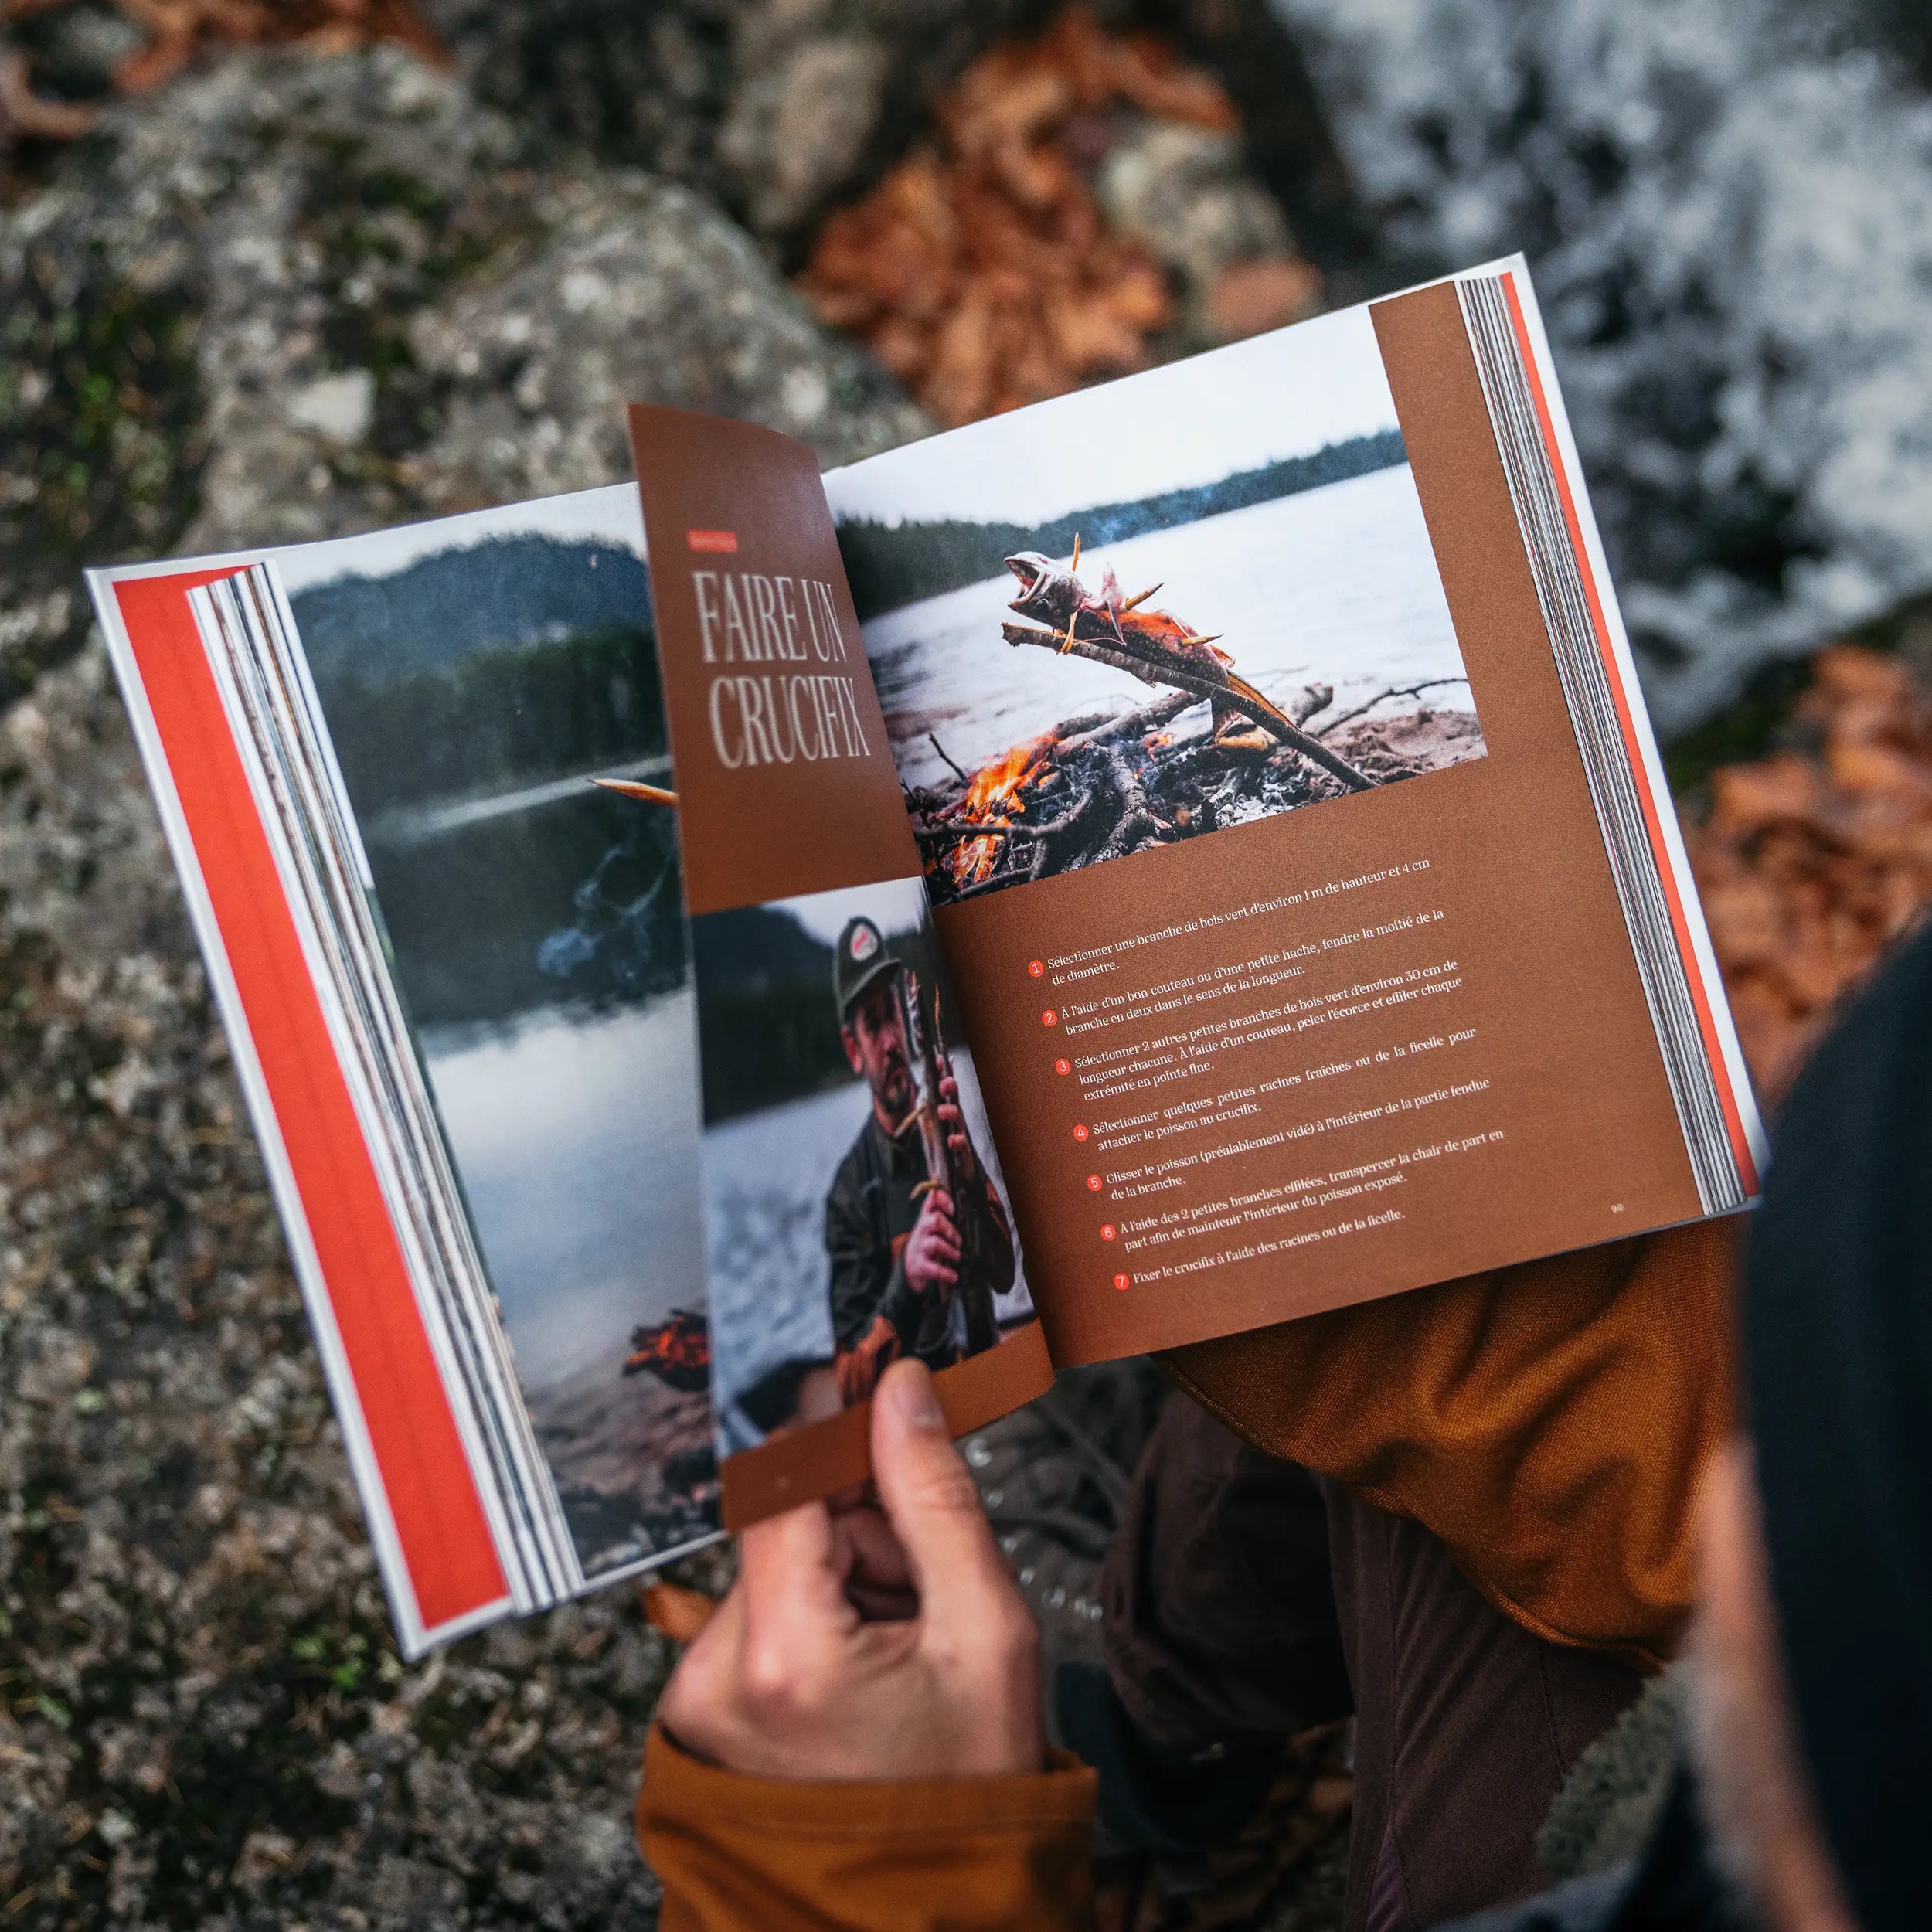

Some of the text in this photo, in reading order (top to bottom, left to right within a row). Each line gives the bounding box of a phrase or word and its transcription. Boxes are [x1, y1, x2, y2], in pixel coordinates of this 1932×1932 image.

[692, 571, 847, 662] FAIRE UN
[709, 675, 870, 768] CRUCIFIX
[1032, 860, 1430, 974] 1 Sélectionner une branche de bois vert d'environ 1 m de hauteur et 4 cm
[1046, 910, 1444, 1023] 2 À l'aide d'un bon couteau ou d'une petite hache, fendre la moitié de la
[1053, 962, 1119, 985] de diamètre.
[1066, 967, 1304, 1035] branche en deux dans le sens de la longueur.
[1060, 961, 1458, 1072] 3 Sélectionner 2 autres petites branches de bois vert d'environ 30 cm de
[1079, 978, 1462, 1084] longueur chacune. À l'aide d'un couteau, peler l'écorce et effiler chaque
[1078, 1029, 1475, 1138] 4 Sélectionner quelques petites racines fraîches ou de la ficelle pour
[1084, 1063, 1214, 1100] extrémité en pointe fine.
[1098, 1104, 1261, 1151] attacher le poisson au crucifix.
[1090, 1080, 1490, 1188] 5 Glisser le poisson (préalablement vidé) à l'intérieur de la partie fendue
[1104, 1131, 1504, 1238] 6 À l'aide des 2 petites branches effilées, transpercer la chair de part en
[1111, 1177, 1185, 1200] de la branche.
[1124, 1172, 1407, 1253] part afin de maintenir l'intérieur du poisson exposé.
[1117, 1210, 1405, 1287] 7 Fixer le crucifix à l'aide des racines ou de la ficelle.
